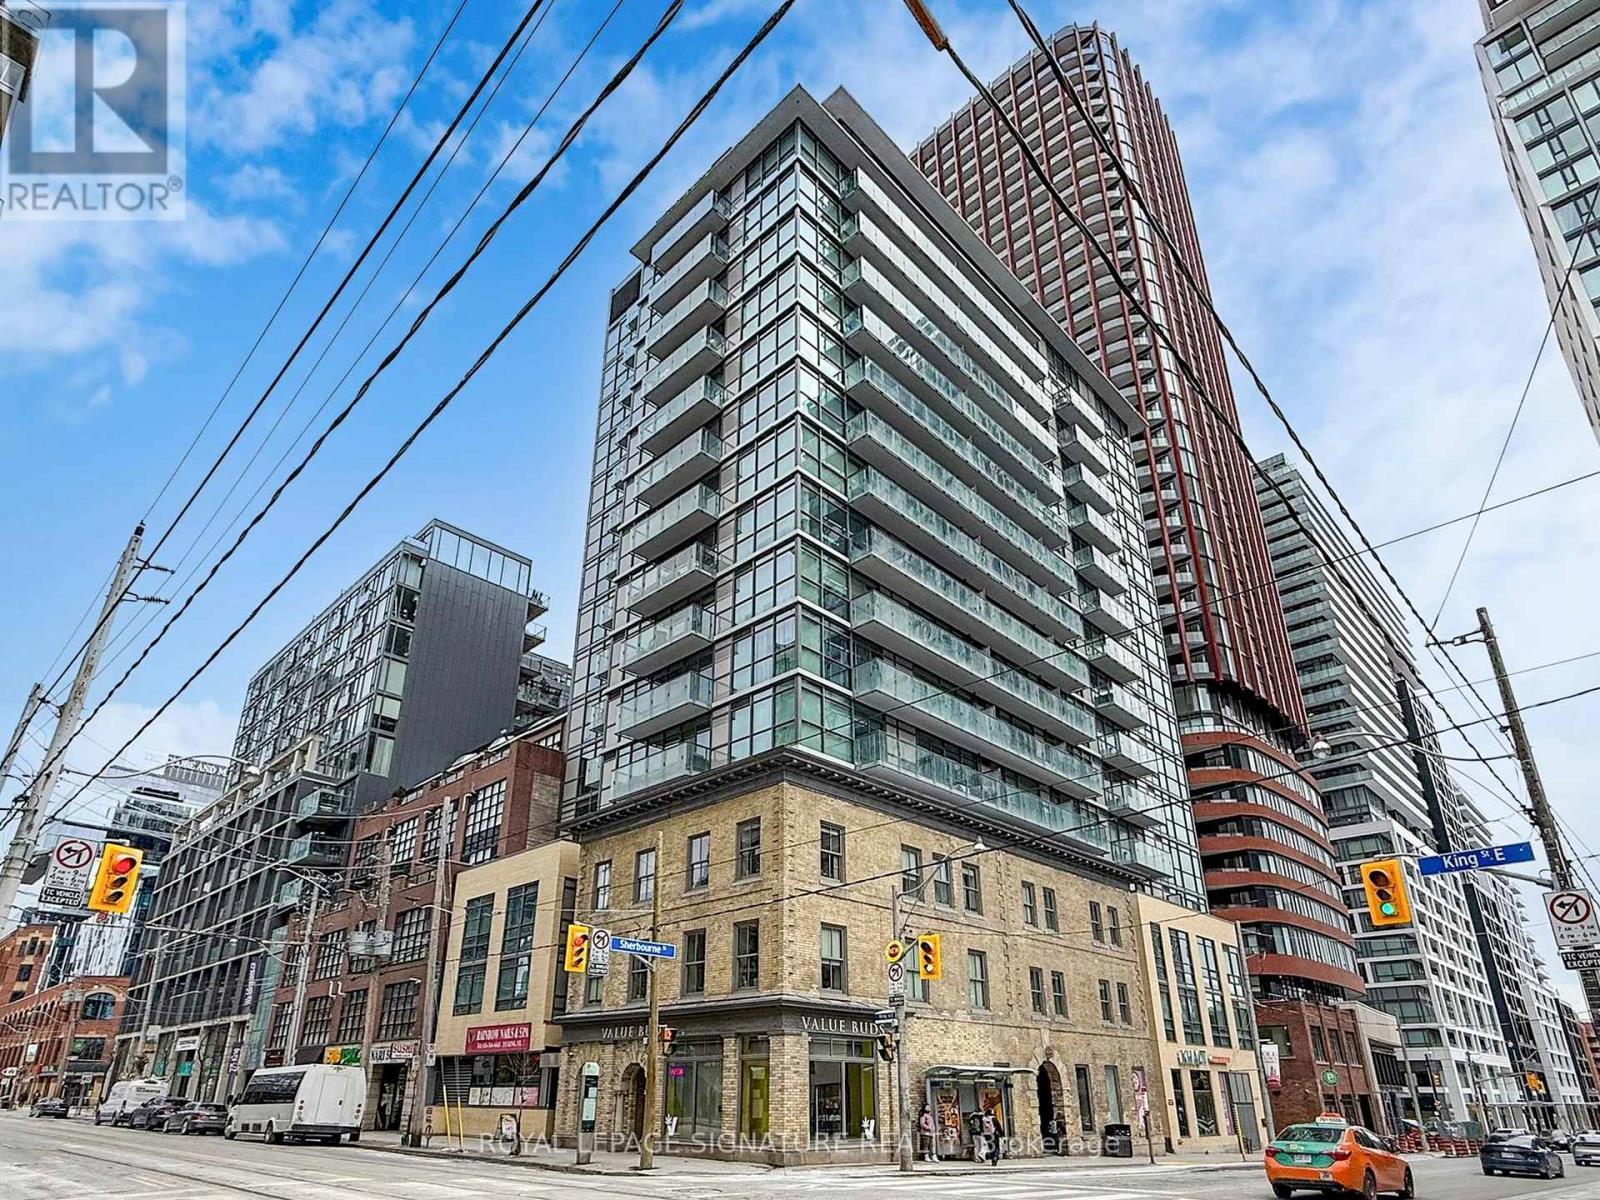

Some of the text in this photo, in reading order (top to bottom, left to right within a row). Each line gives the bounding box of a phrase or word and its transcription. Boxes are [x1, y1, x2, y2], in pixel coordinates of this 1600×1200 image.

[1442, 848, 1506, 869] King St E
[619, 940, 662, 954] Sherbourne
[602, 1026, 635, 1039] VALUE
[801, 1015, 886, 1036] VALUE BUDS
